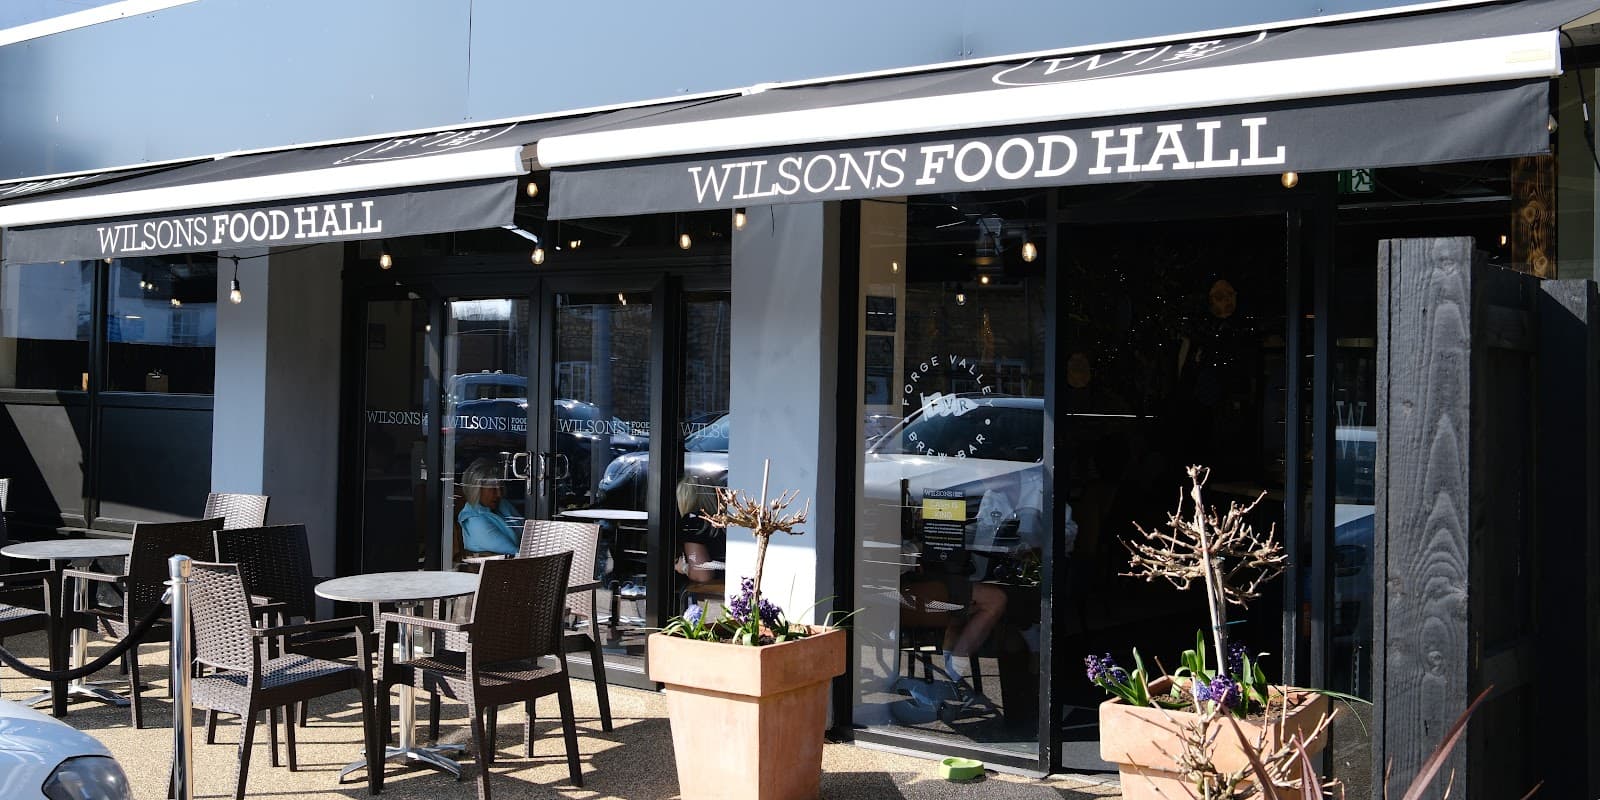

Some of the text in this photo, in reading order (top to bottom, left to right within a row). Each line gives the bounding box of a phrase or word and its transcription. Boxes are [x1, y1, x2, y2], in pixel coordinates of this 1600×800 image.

[688, 117, 1286, 203] WILSONS FOOD HALL
[97, 200, 382, 254] WILSONS FOOD HALL
[902, 354, 994, 407] FORGE VALLEY
[366, 411, 421, 425] WILSONS
[447, 415, 508, 431] WILSONS
[559, 418, 626, 434] WILSONS
[908, 431, 986, 461] BREW BAR
